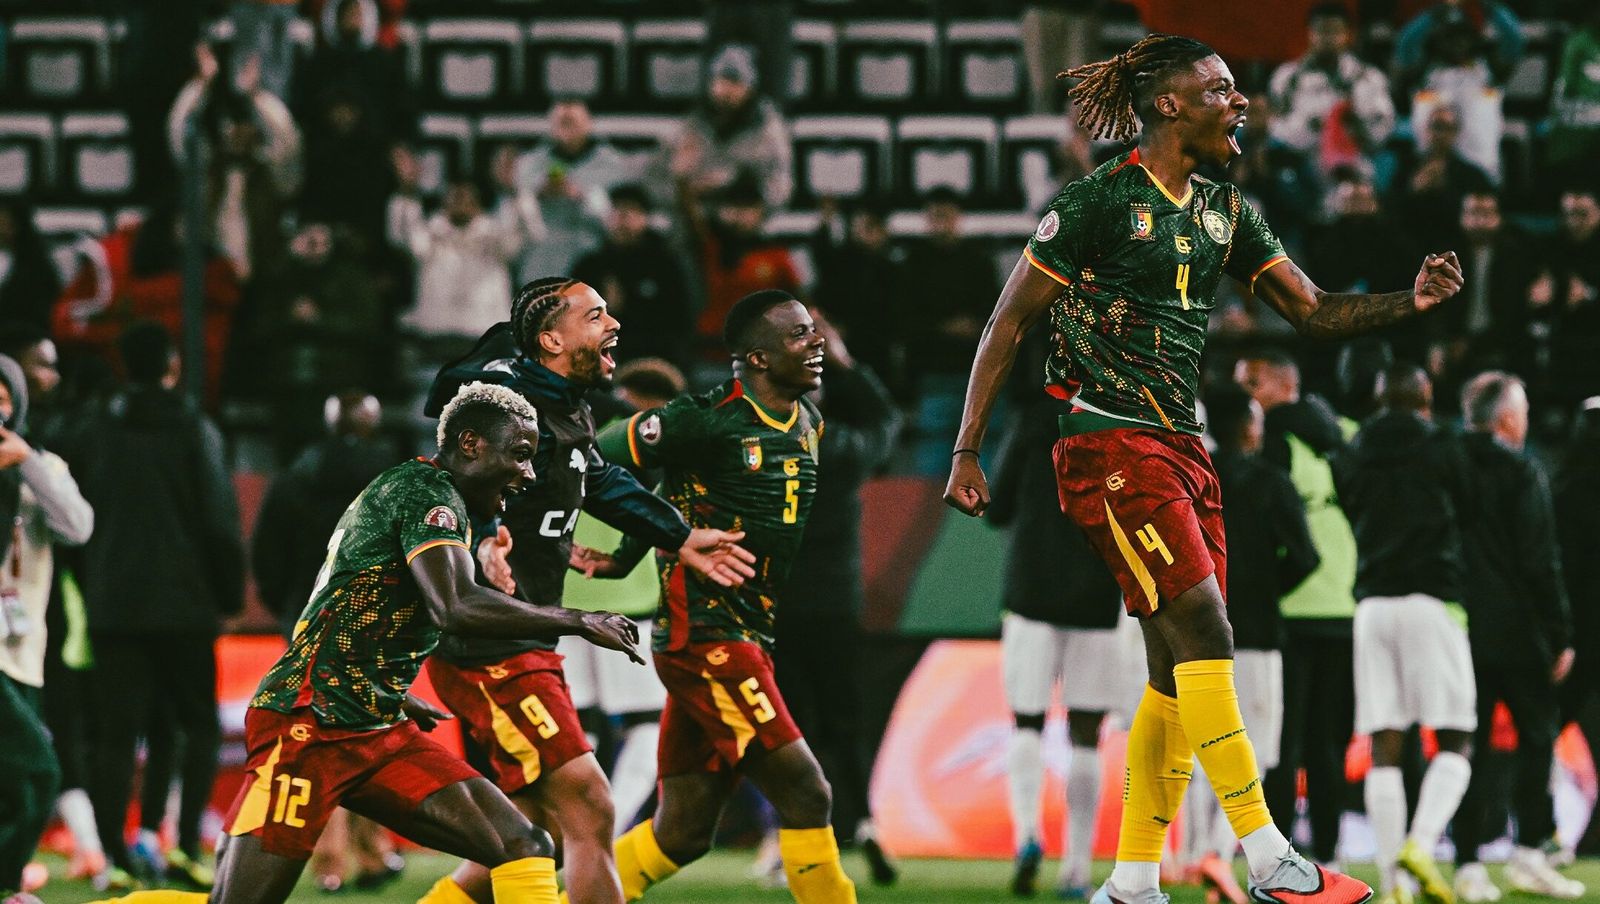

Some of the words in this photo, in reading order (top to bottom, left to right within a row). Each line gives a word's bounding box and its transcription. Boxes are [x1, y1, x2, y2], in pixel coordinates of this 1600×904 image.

[1176, 264, 1190, 310] 4
[782, 479, 800, 524] 5
[1136, 523, 1175, 566] 4
[519, 694, 560, 740] 9
[739, 677, 776, 724] 5
[273, 774, 312, 829] 12
